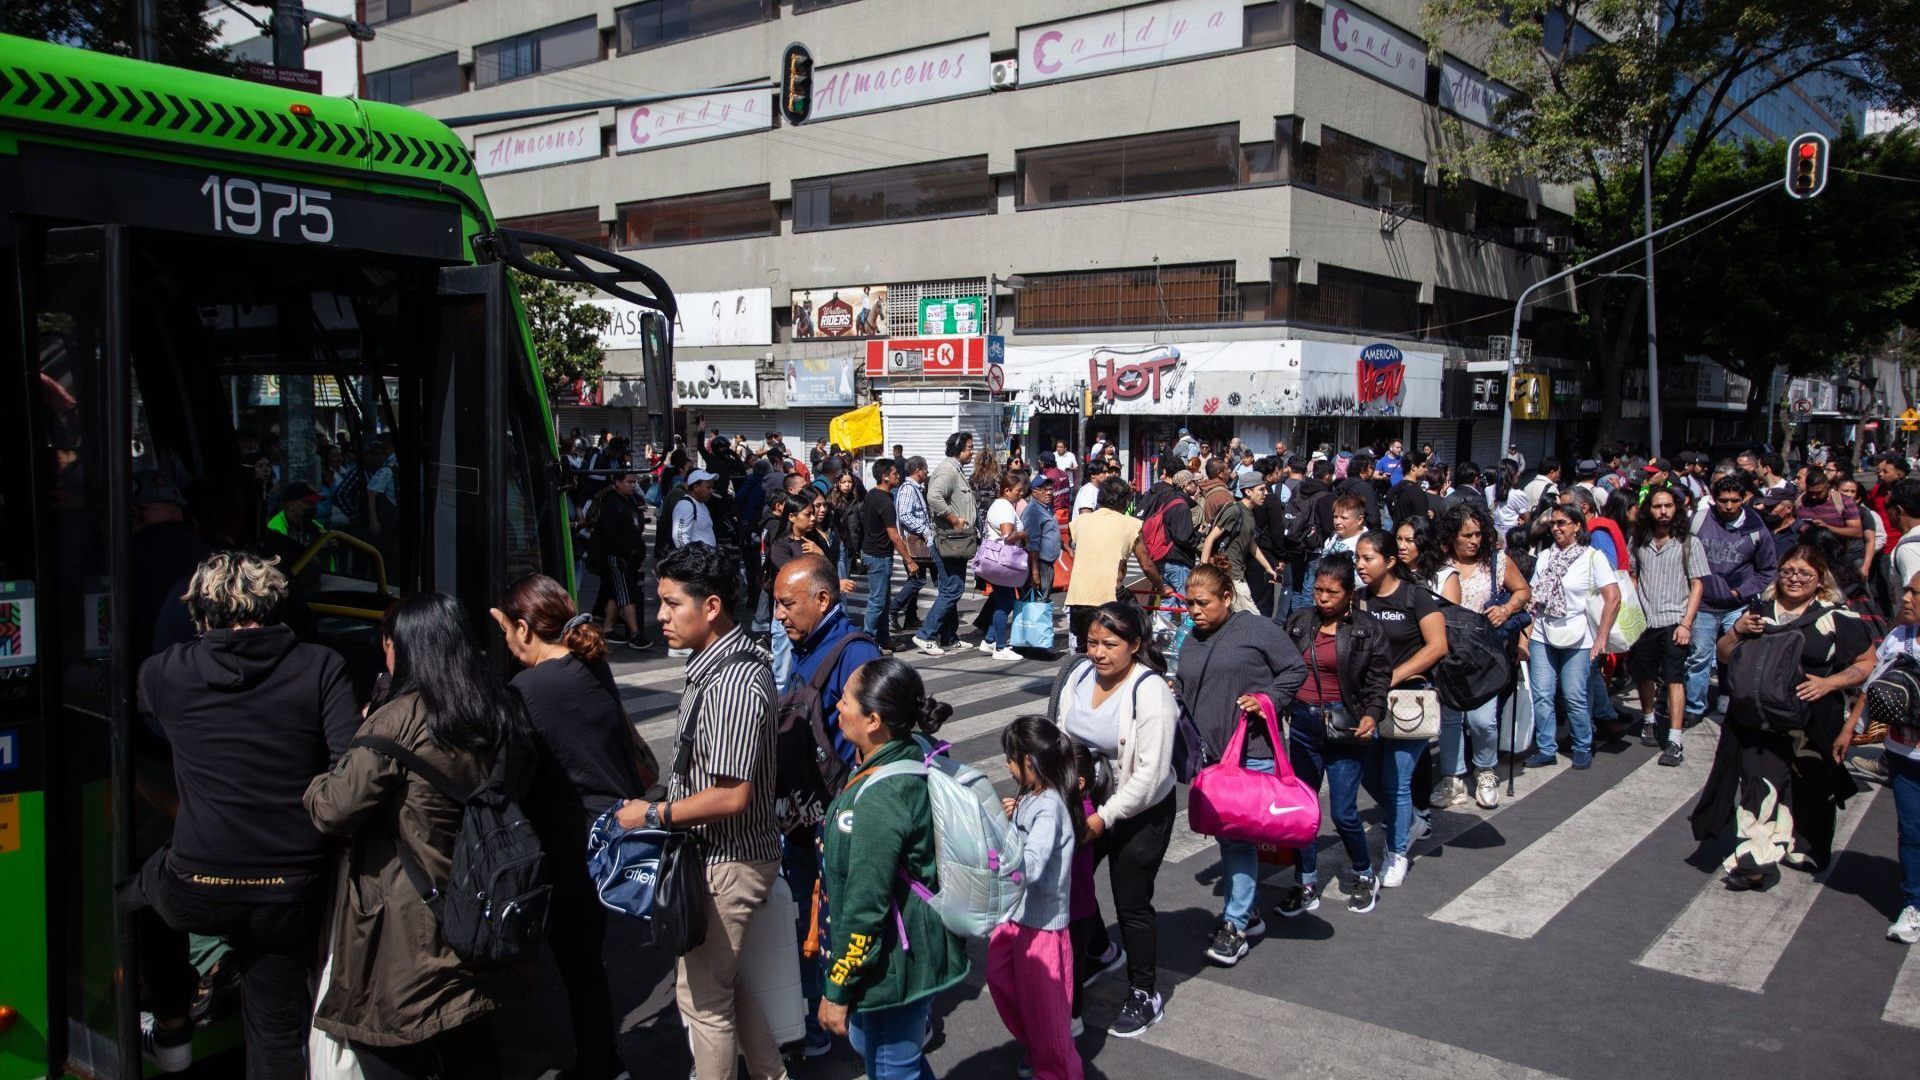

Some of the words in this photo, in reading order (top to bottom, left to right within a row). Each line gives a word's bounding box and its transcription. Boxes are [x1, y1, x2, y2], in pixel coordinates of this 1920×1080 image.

[1033, 8, 1225, 75] Candya
[814, 52, 965, 113] Almacenes
[630, 98, 757, 145] Candya
[489, 125, 585, 167] Almacenes
[201, 175, 334, 243] 1975
[820, 315, 851, 327] RIDERS
[941, 347, 953, 363] K
[1364, 349, 1399, 360] AMERICAN
[676, 380, 709, 399] BAO
[720, 380, 753, 399] TEA
[1089, 357, 1176, 402] HOT
[1382, 610, 1405, 621] Klein
